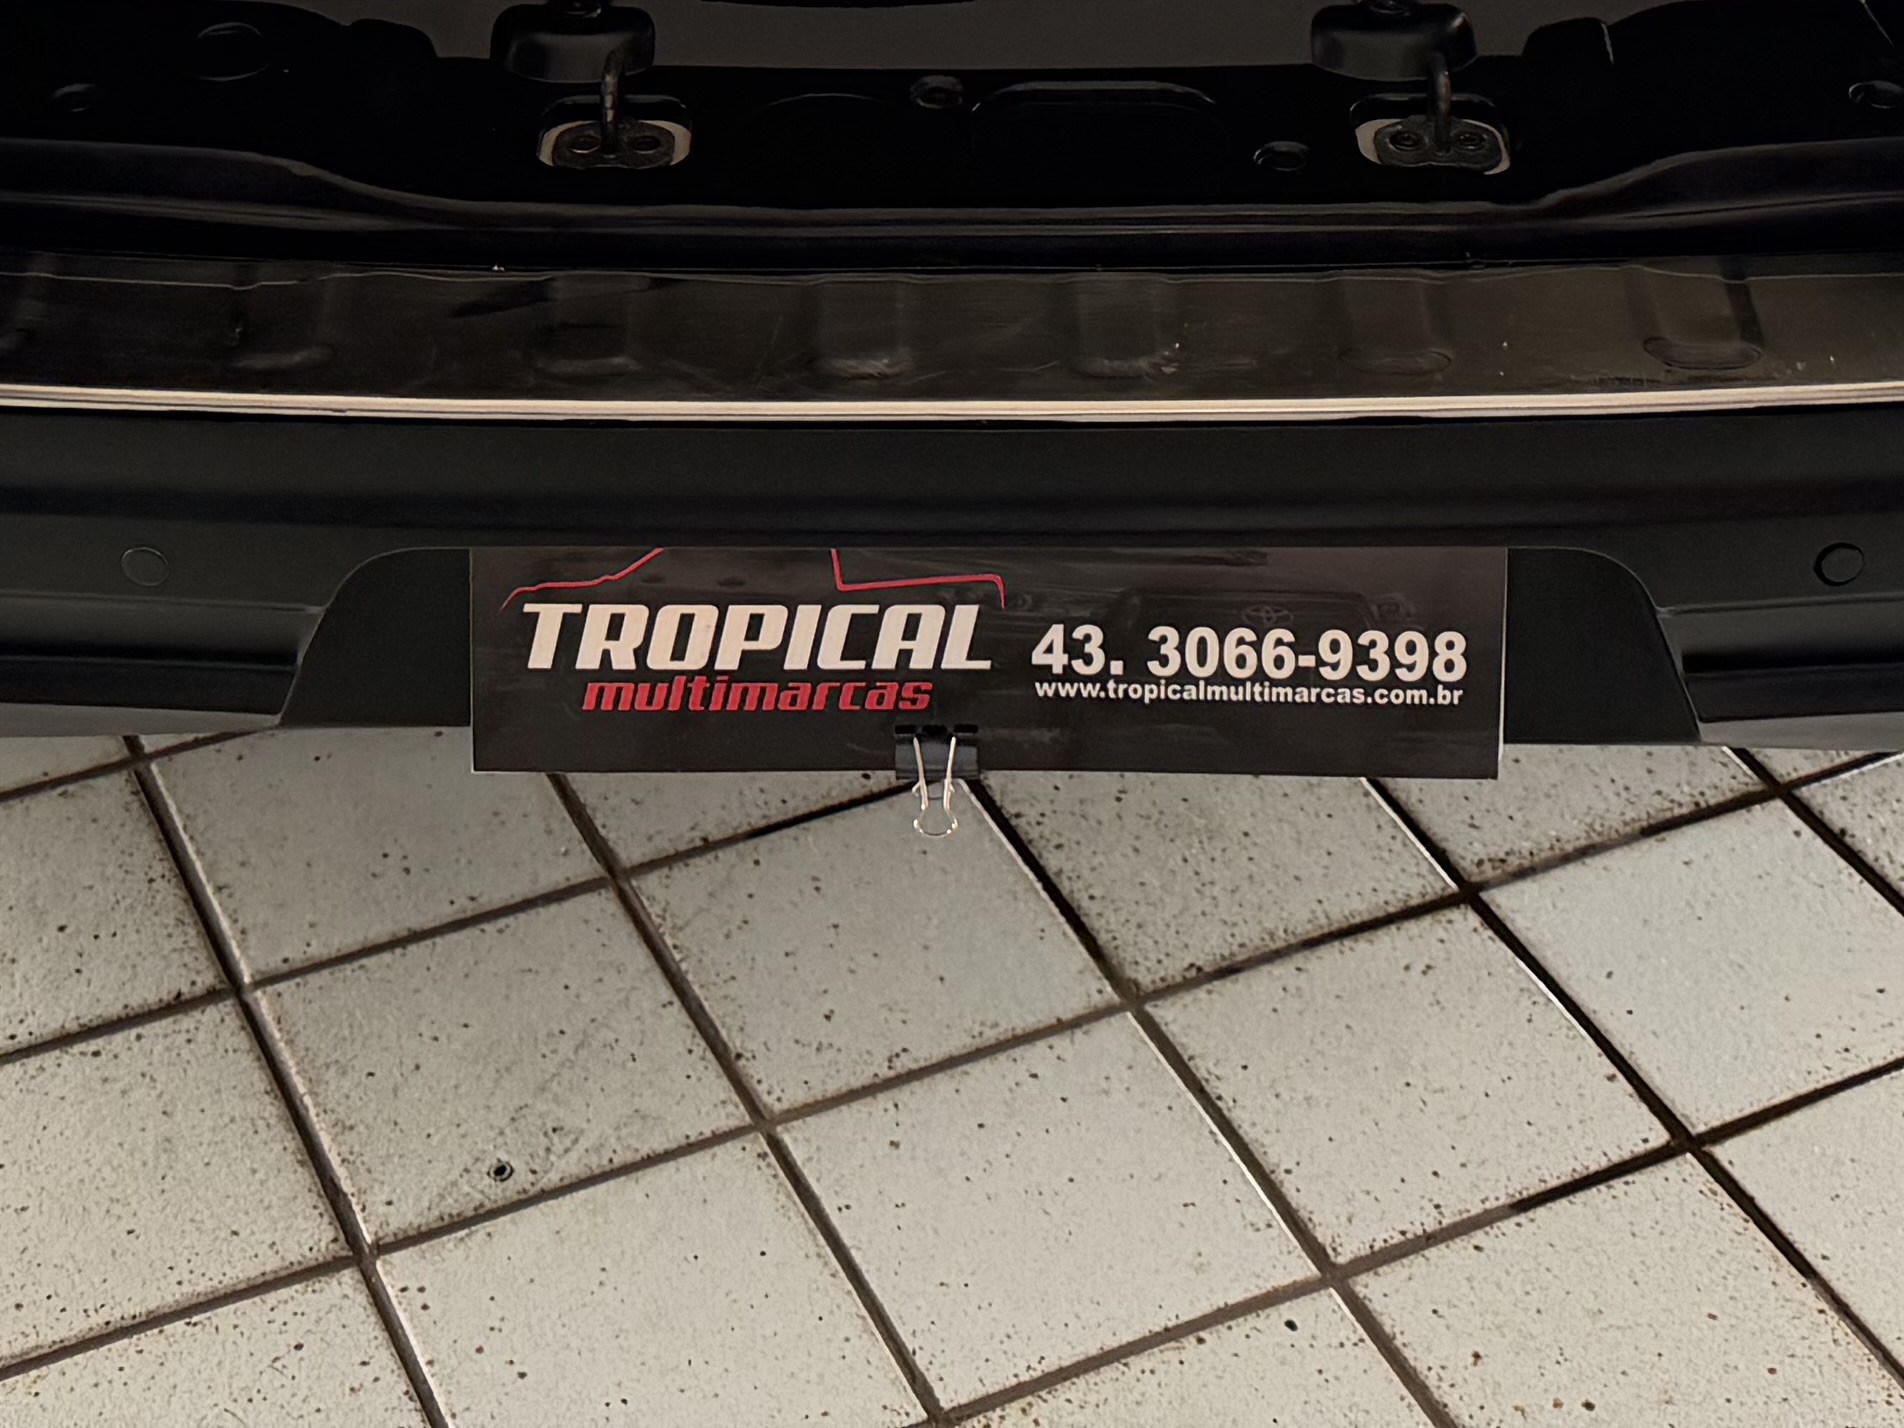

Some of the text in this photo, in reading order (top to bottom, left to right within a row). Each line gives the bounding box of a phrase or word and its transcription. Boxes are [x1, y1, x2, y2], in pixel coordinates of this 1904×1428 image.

[523, 603, 992, 670] TROPICAL
[1030, 623, 1468, 684] 43. 3066-9398
[581, 675, 933, 711] multimarcas
[1034, 678, 1464, 706] www.tropicalmultimarcas.com.br
